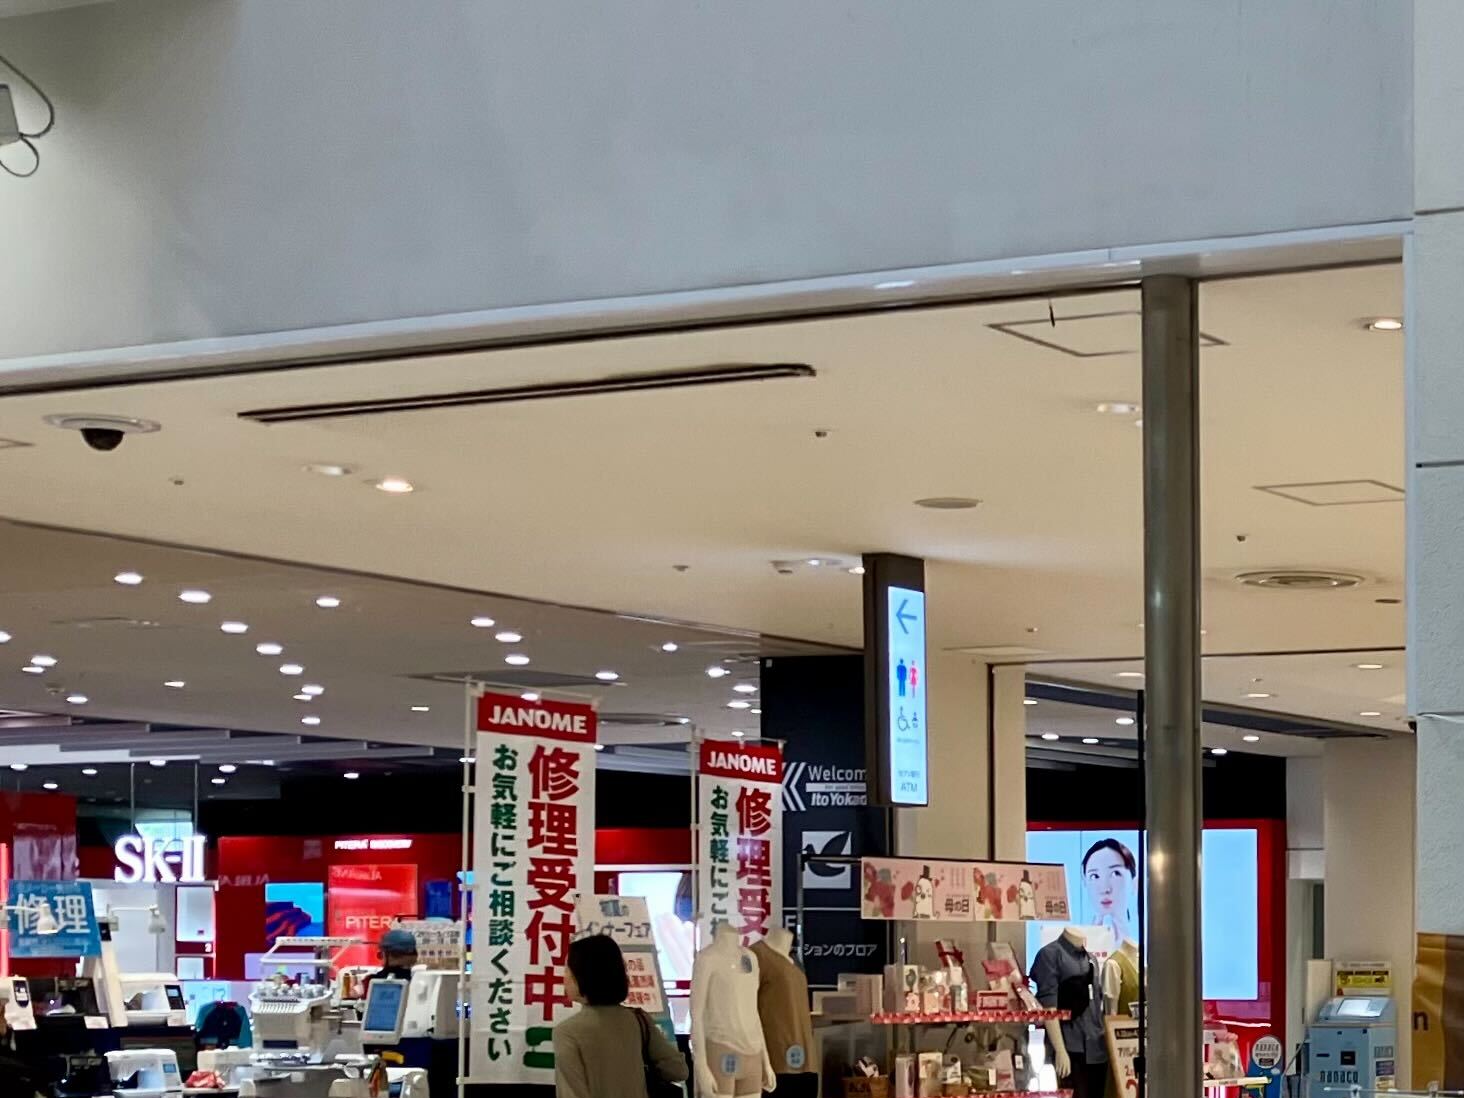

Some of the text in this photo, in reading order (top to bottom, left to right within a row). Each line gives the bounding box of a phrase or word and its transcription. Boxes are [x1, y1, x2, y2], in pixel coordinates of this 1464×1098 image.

[488, 704, 588, 735] JANOME
[706, 749, 777, 777] JANOME
[114, 834, 206, 883] SK-II
[735, 786, 772, 944] 修理受
[487, 743, 520, 1063] お気軽にご相談ください
[524, 743, 581, 1023] 修理受付中
[16, 892, 91, 935] 修理
[803, 942, 878, 957] ションのフロア
